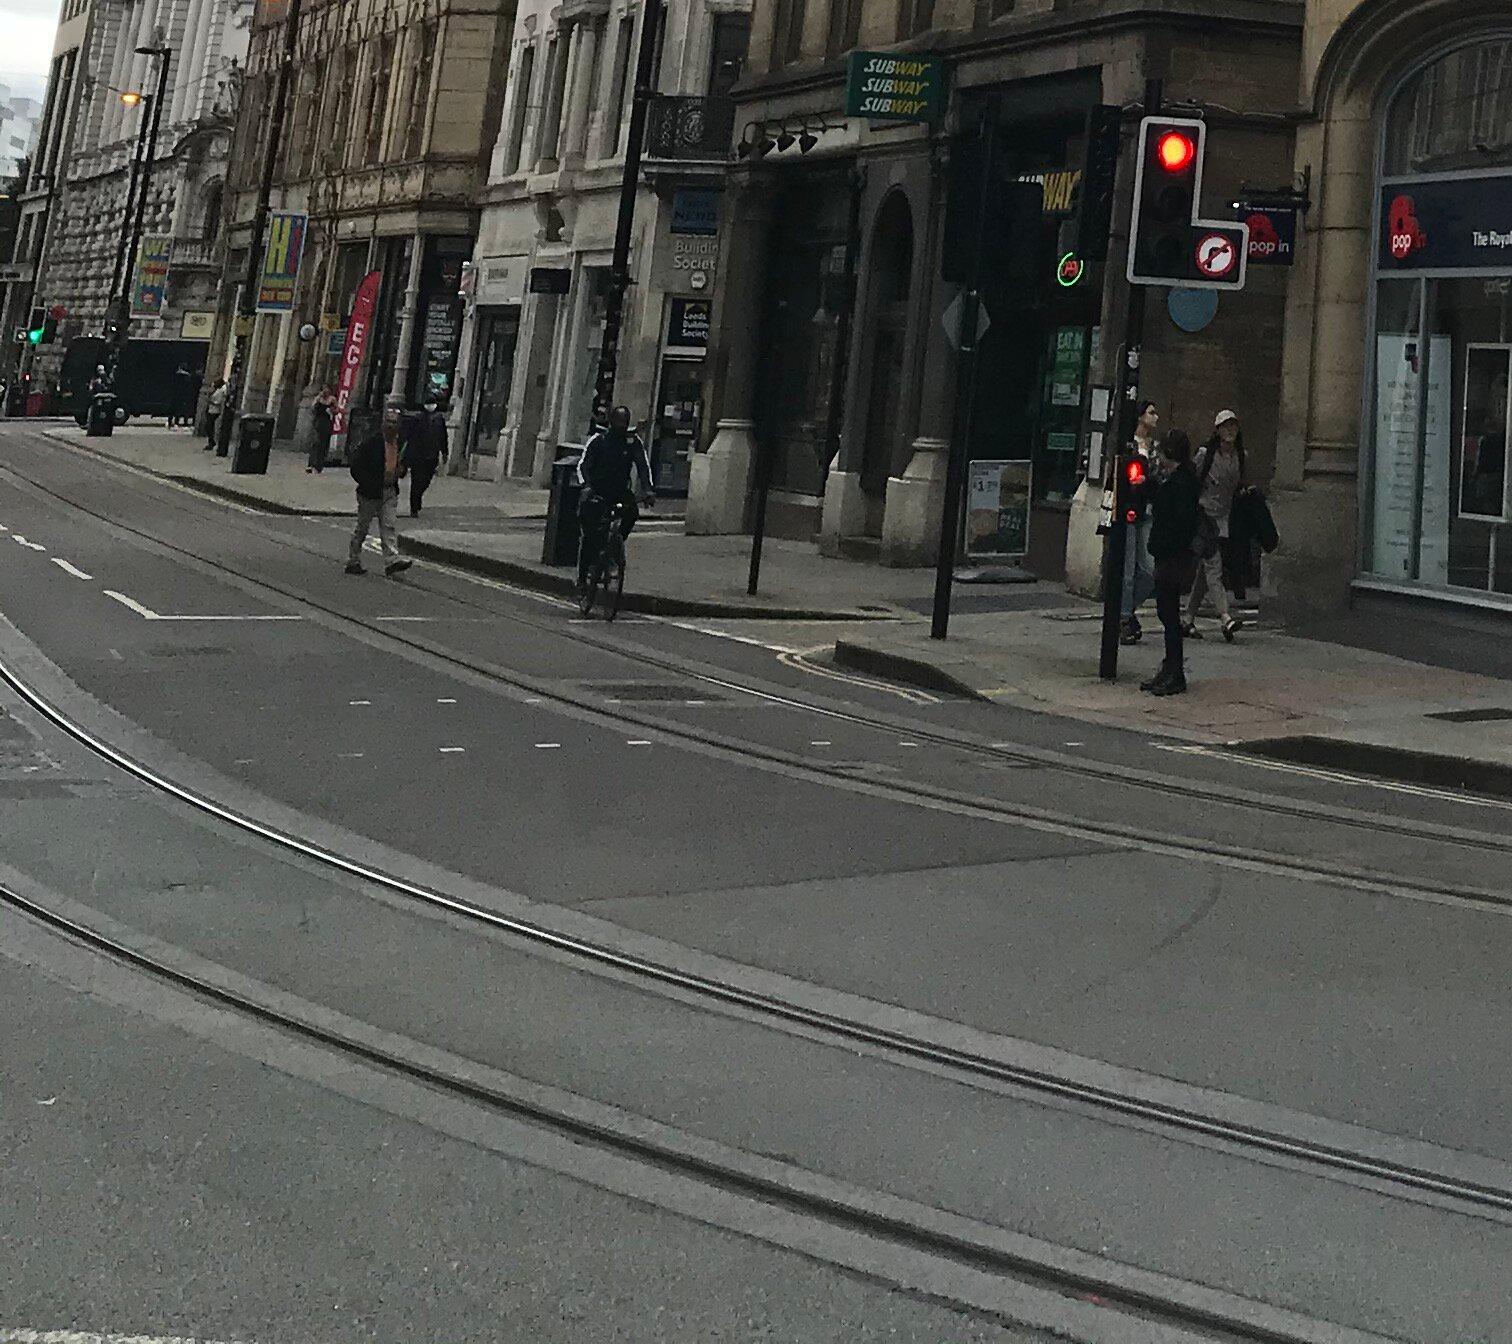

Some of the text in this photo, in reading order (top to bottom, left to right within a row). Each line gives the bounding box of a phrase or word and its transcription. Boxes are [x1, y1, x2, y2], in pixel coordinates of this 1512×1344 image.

[863, 58, 932, 76] SUBWAY
[861, 77, 930, 95] SUBWAY
[860, 97, 928, 114] SUBWAY
[1249, 238, 1290, 255] pop in
[1392, 233, 1412, 253] pop
[1473, 231, 1488, 246] The
[674, 241, 719, 254] Buildin
[673, 255, 717, 271] Societ
